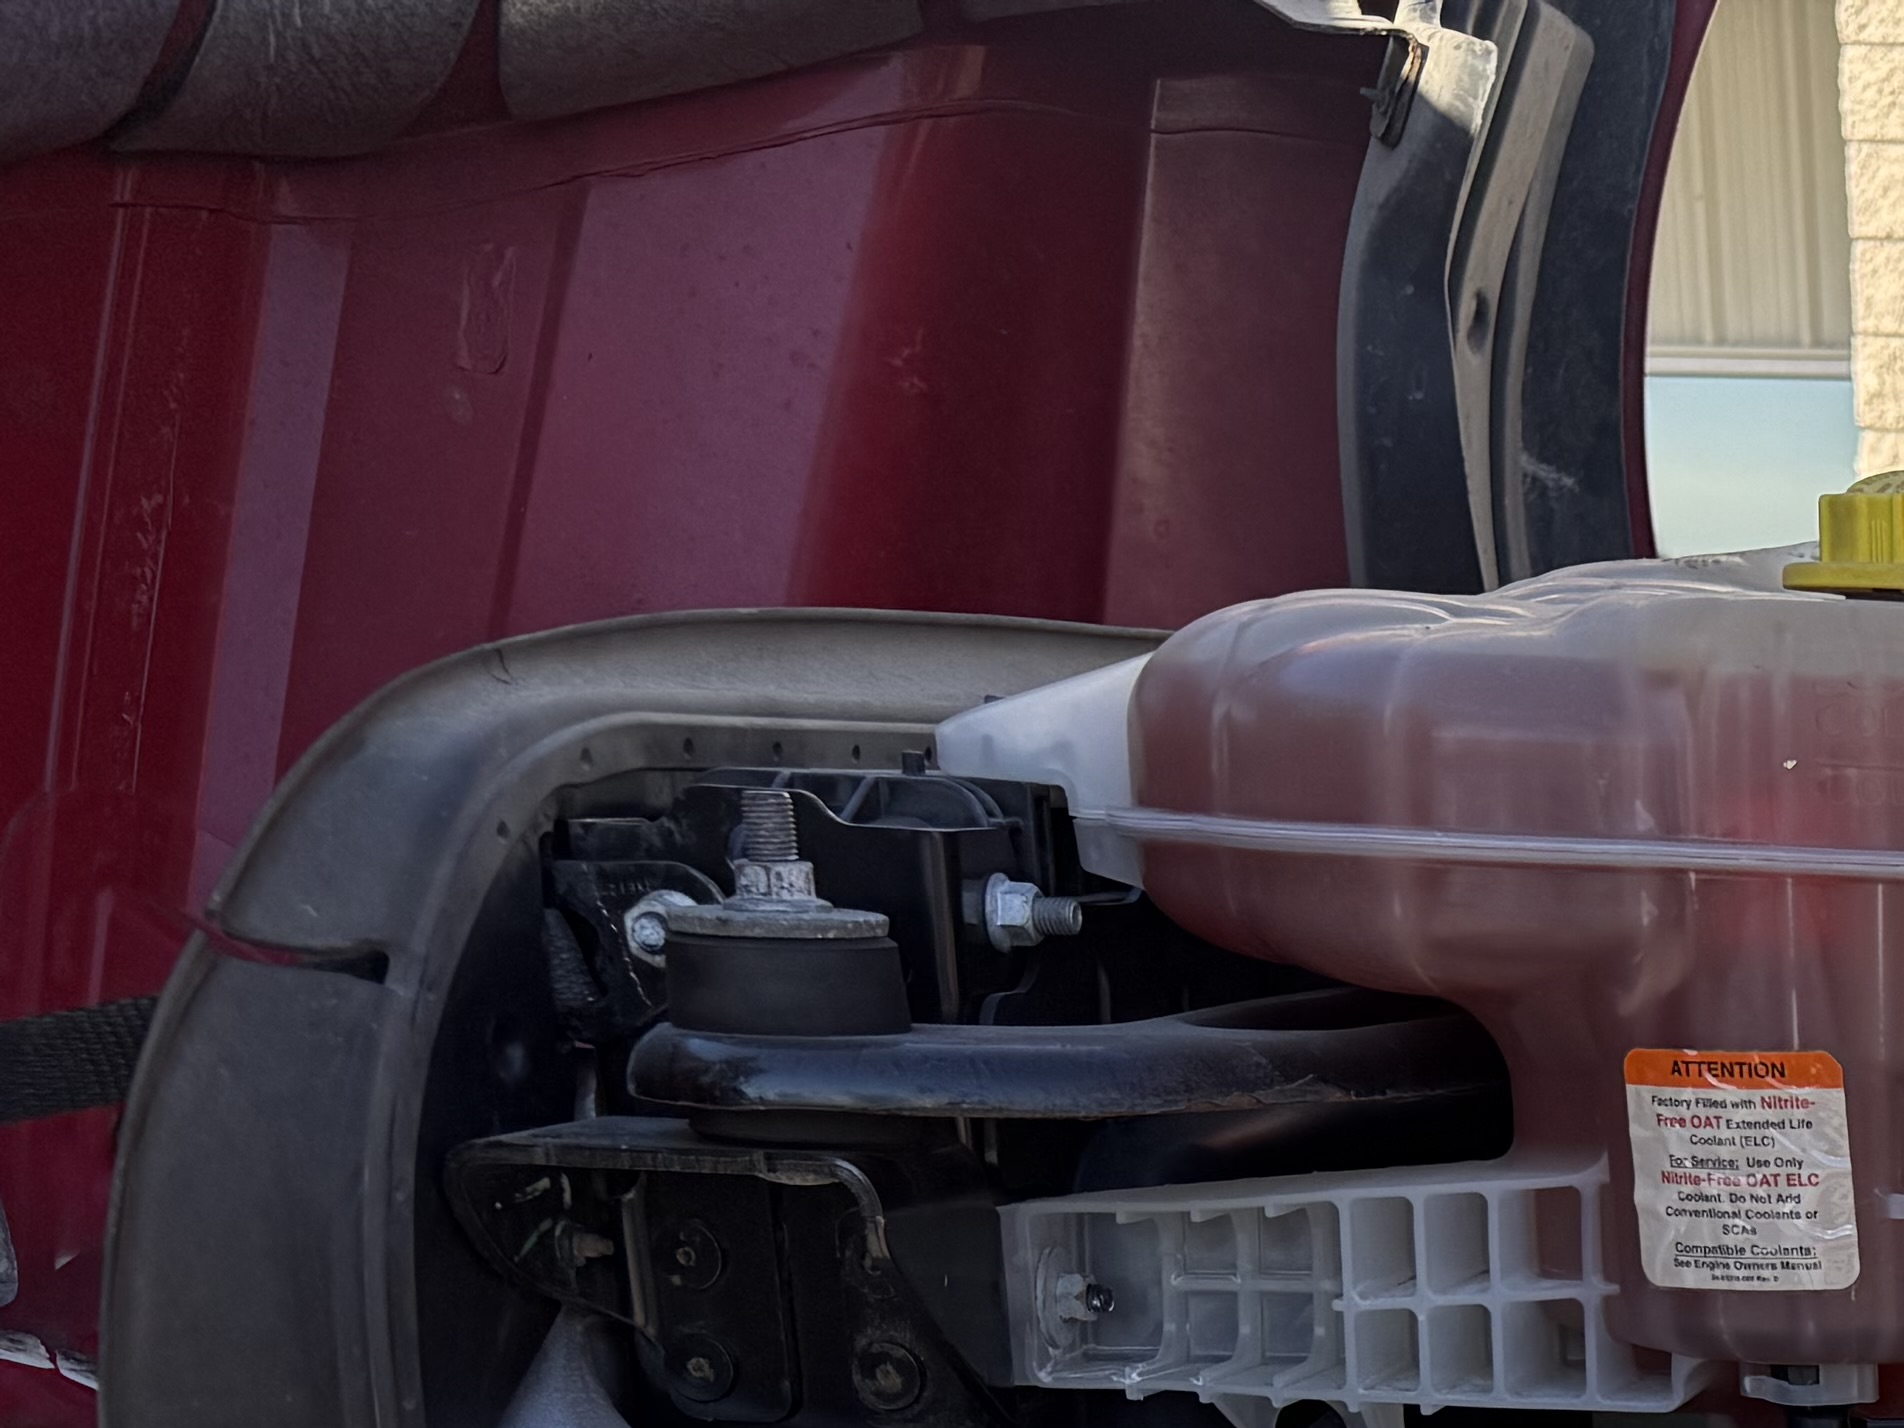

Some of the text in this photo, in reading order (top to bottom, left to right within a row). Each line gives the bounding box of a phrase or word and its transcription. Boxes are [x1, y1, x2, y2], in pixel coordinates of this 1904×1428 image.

[1671, 1060, 1786, 1078] ATTENTION
[1652, 1096, 1816, 1110] Factory Filled with Nitrite-
[1656, 1114, 1813, 1130] Free OAT Extended Life
[1690, 1134, 1776, 1149] Coolant (ELC)
[1746, 1156, 1771, 1168] Use
[1774, 1157, 1804, 1170] Only
[1661, 1171, 1820, 1187] Nitrite-Free OAT ELC
[1678, 1191, 1801, 1204] Coolant. Do Not Add
[1665, 1206, 1818, 1220] Conventional Coolants or
[1722, 1224, 1757, 1235] SCAs
[1675, 1242, 1817, 1257] Compatible Coolants:
[1673, 1259, 1822, 1272] See Engine Owners Manual
